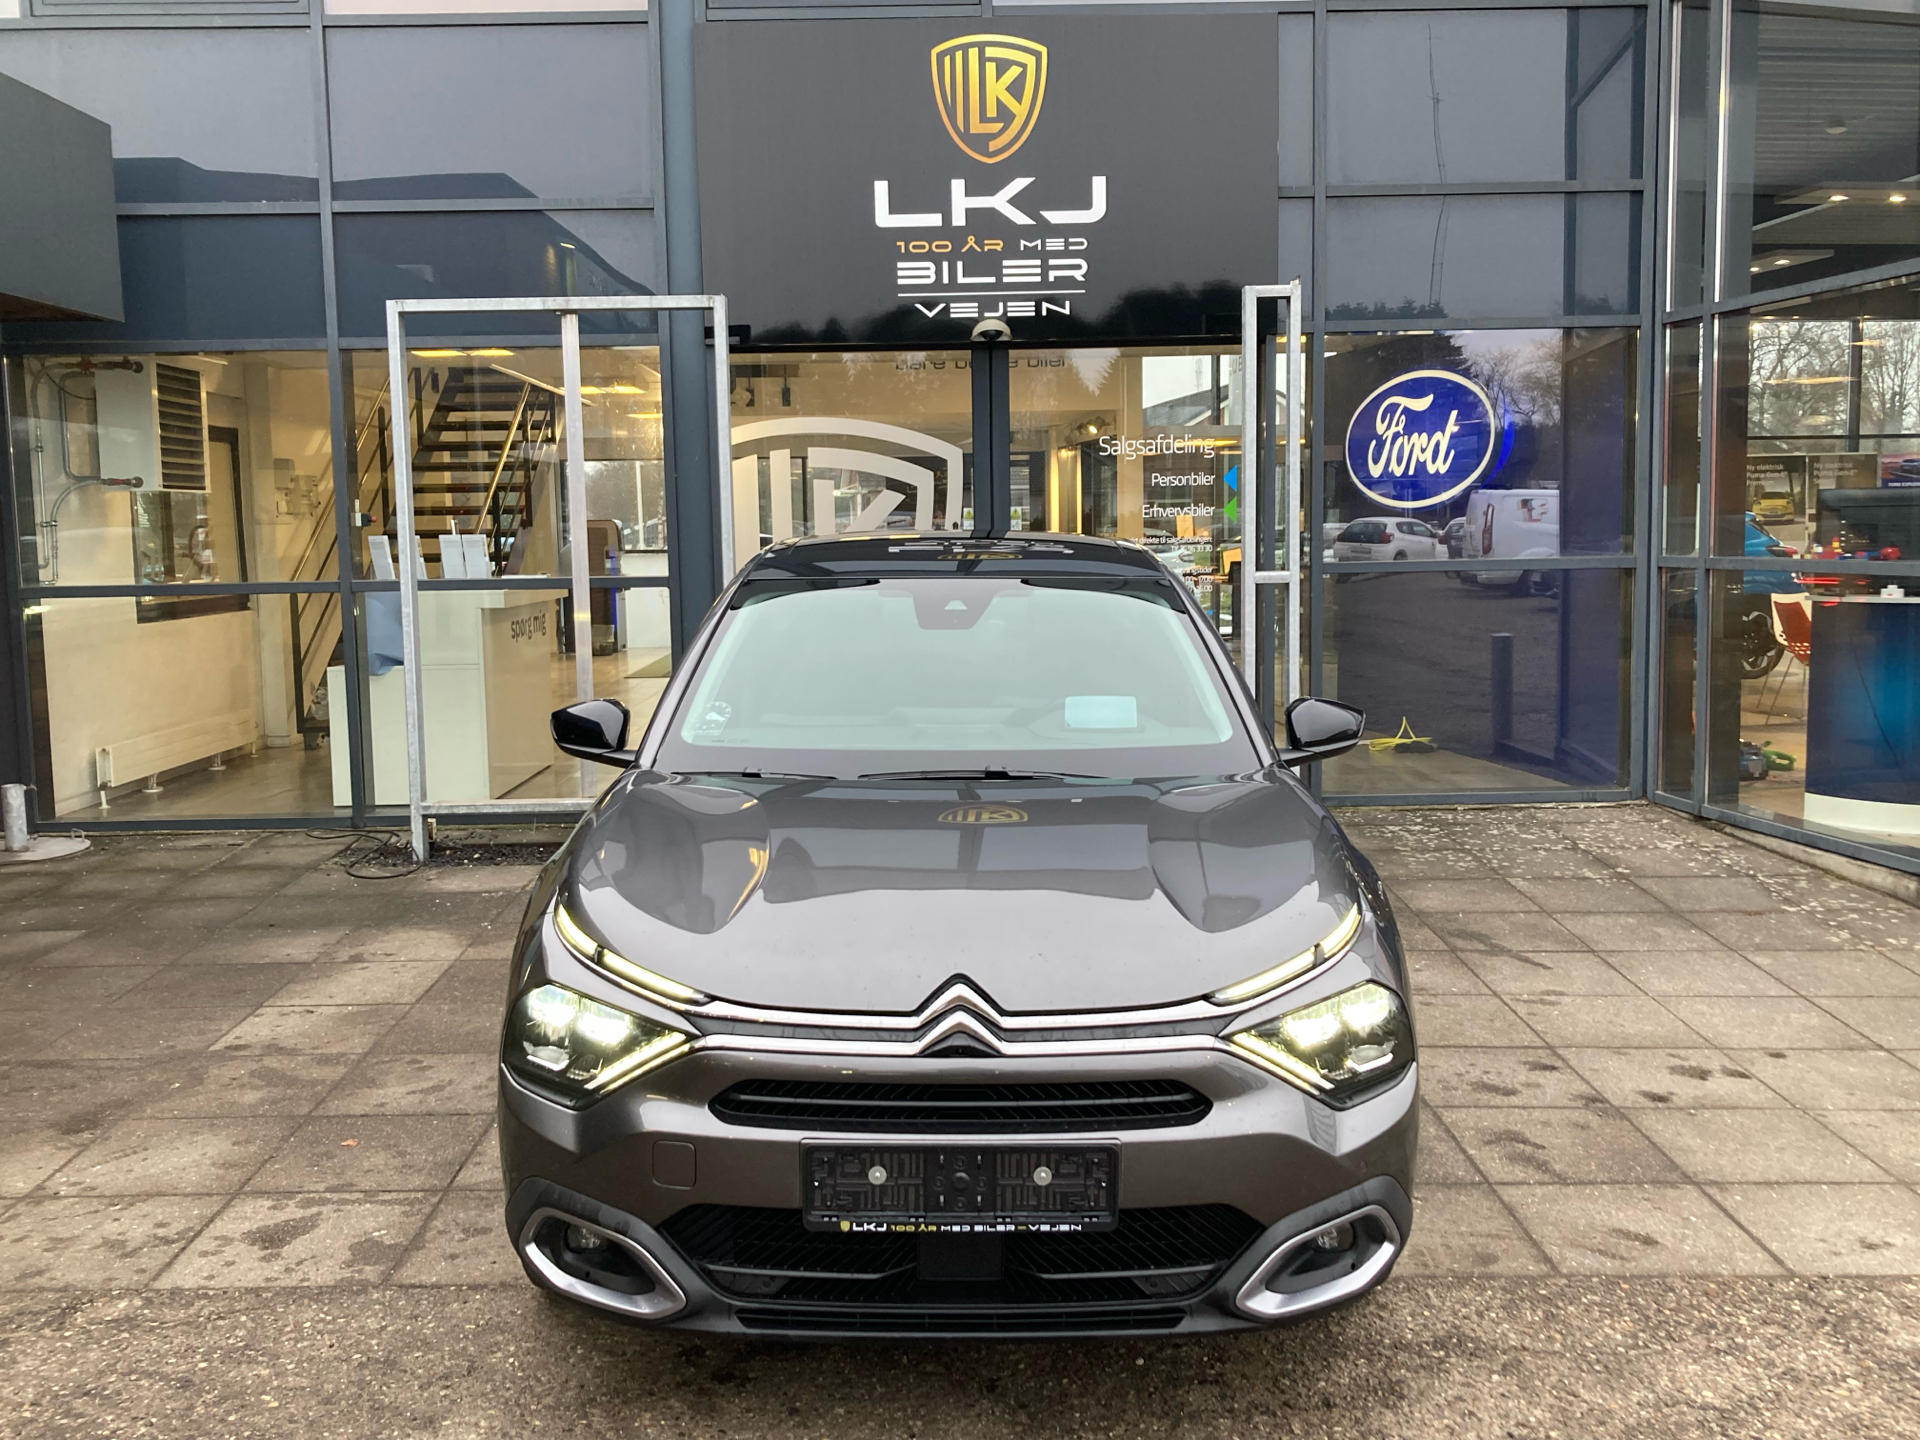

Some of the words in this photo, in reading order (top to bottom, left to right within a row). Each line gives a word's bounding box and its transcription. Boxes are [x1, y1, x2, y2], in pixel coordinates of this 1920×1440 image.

[874, 176, 1107, 227] LKJ
[896, 240, 952, 253] 100
[960, 235, 1004, 252] ÅR
[1020, 237, 1088, 251] MED
[896, 258, 1088, 284] BILER
[914, 300, 1071, 318] VEJEN
[1099, 434, 1215, 460] Salgsafdeling
[1367, 393, 1458, 479] Ford
[1151, 472, 1215, 487] Personbiler
[1142, 504, 1215, 518] Erhvervsbiler
[511, 616, 532, 643] spørg
[533, 609, 547, 637] mig
[852, 1222, 887, 1232] LKJ
[890, 1224, 915, 1232] 100
[918, 1223, 937, 1232] ÅR
[941, 1224, 971, 1232] MED
[974, 1224, 1015, 1232] BILER
[1028, 1224, 1082, 1232] VEJEN
